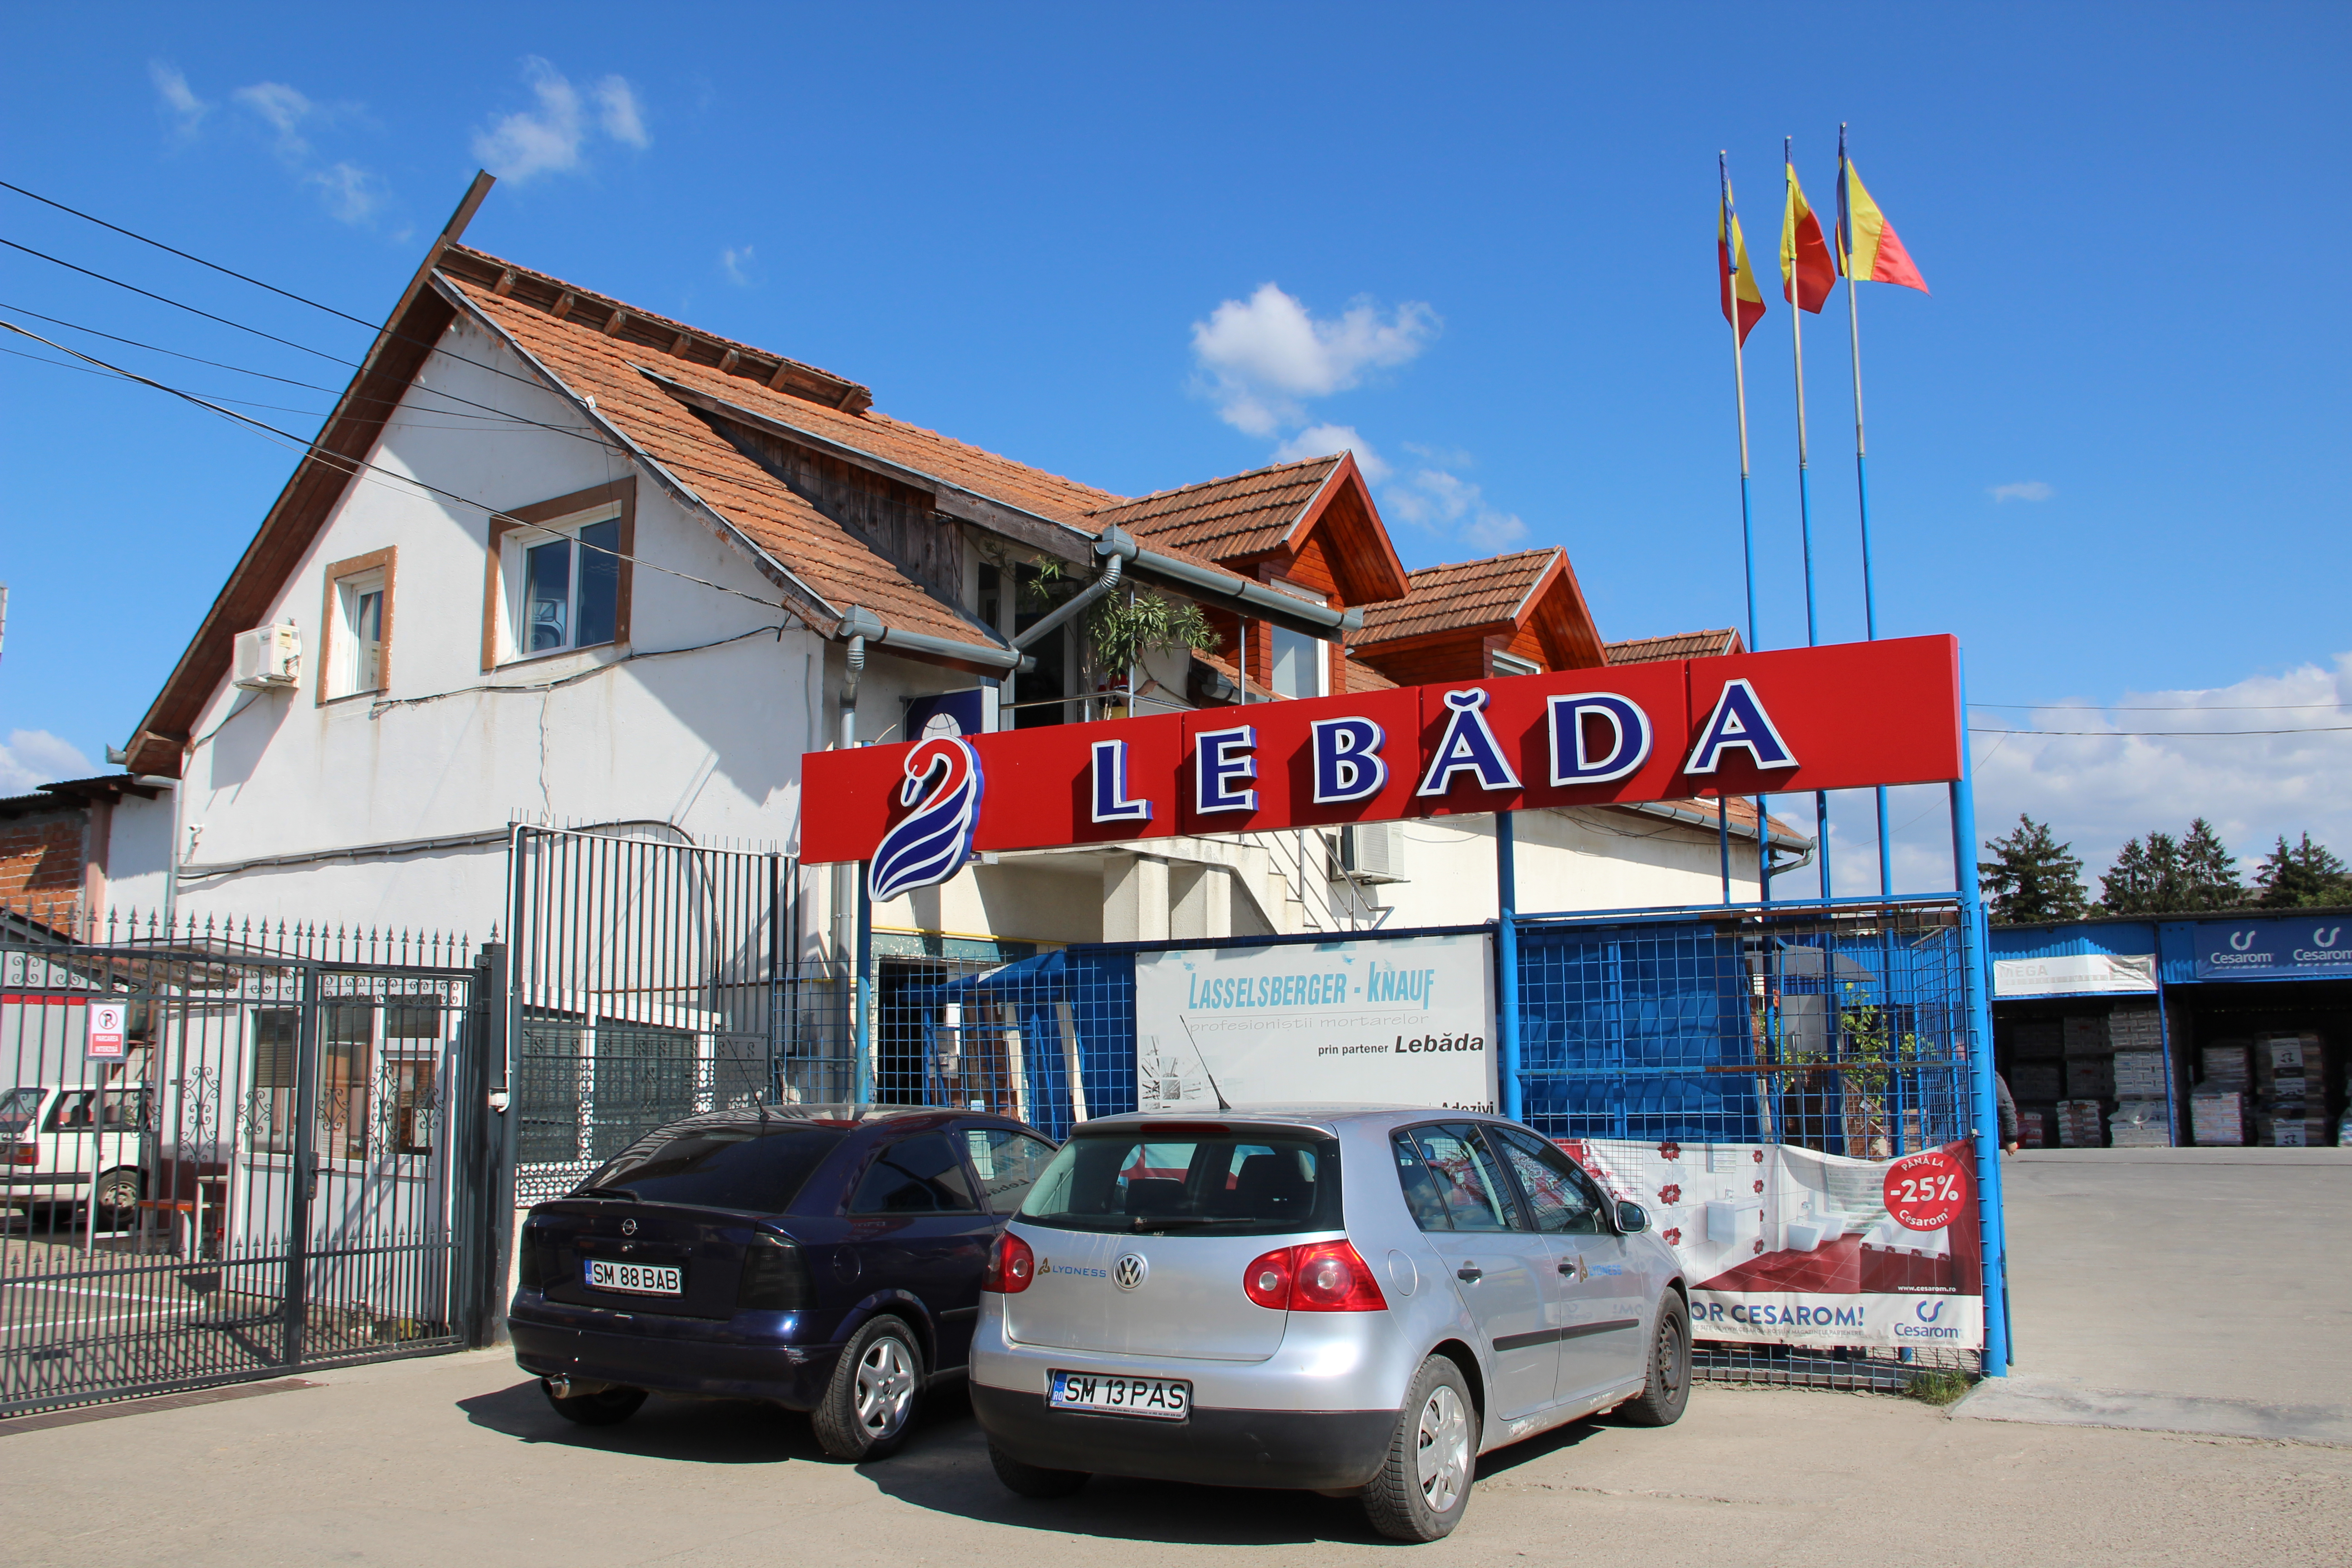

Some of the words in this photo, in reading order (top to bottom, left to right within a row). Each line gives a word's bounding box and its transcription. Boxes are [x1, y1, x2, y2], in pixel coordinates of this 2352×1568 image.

[1092, 678, 1800, 823] LEBĂDA
[2210, 952, 2271, 964] Cesarom
[1999, 965, 2048, 977] MEGA
[1189, 973, 1346, 1009] LASSELSBERGER
[1320, 1013, 1429, 1027] mortarelor
[1318, 1044, 1338, 1056] prin
[1342, 1044, 1388, 1056] partener
[1395, 1032, 1484, 1053] Lebăda
[1901, 1155, 1930, 1171] PÂNĂ
[1932, 1157, 1944, 1167] LA
[1890, 1174, 1959, 1202] -25%
[594, 1264, 614, 1284] SM
[620, 1266, 640, 1287] 88
[642, 1268, 678, 1290] BAB
[1053, 1265, 1106, 1278] LYONESS
[1588, 1265, 1622, 1276] LYONESS
[1731, 1304, 1864, 1327] CESAROM!
[1894, 1323, 1959, 1338] Cesarom
[1054, 1390, 1063, 1401] RO
[1065, 1377, 1097, 1402] SM
[1106, 1379, 1126, 1405] 13
[1130, 1381, 1185, 1409] PAS
